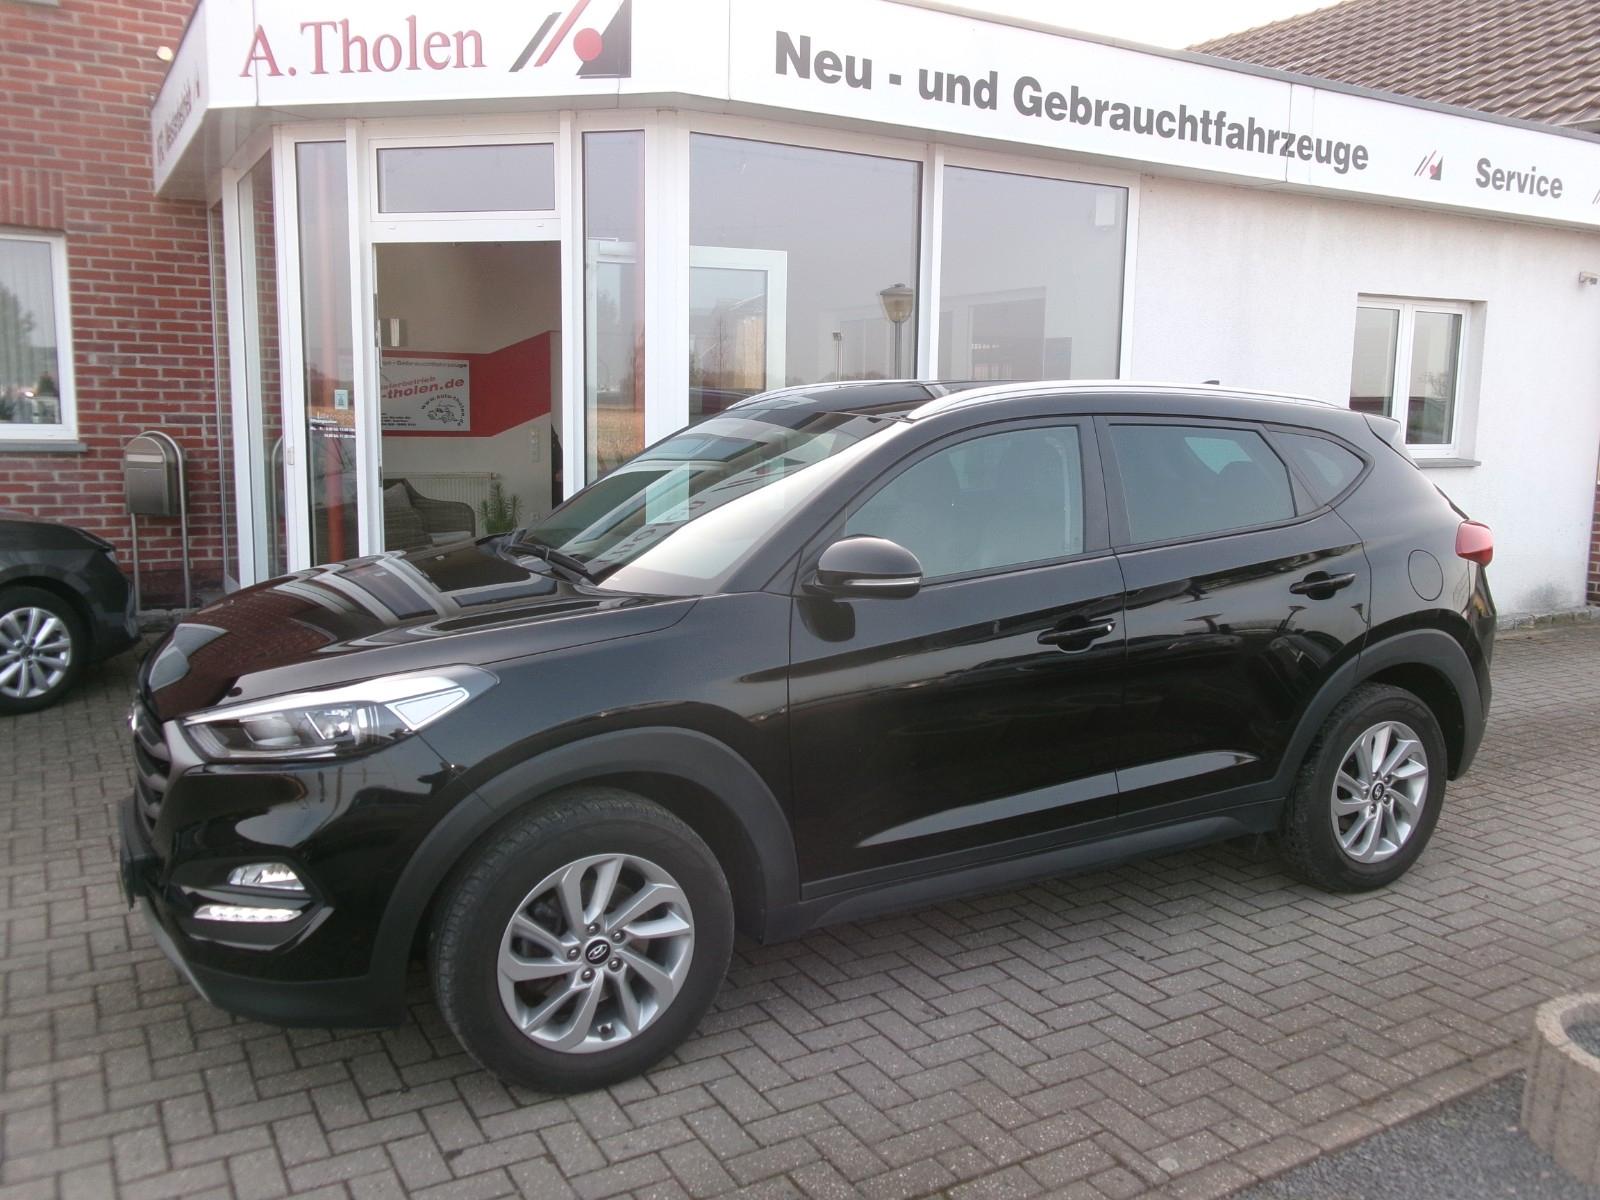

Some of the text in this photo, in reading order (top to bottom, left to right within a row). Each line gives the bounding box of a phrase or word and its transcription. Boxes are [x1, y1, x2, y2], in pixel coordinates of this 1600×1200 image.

[775, 30, 872, 90] Neu
[918, 68, 998, 110] und
[1013, 76, 1369, 175] Gebrauchtfahrzeuge
[1475, 157, 1563, 199] Service
